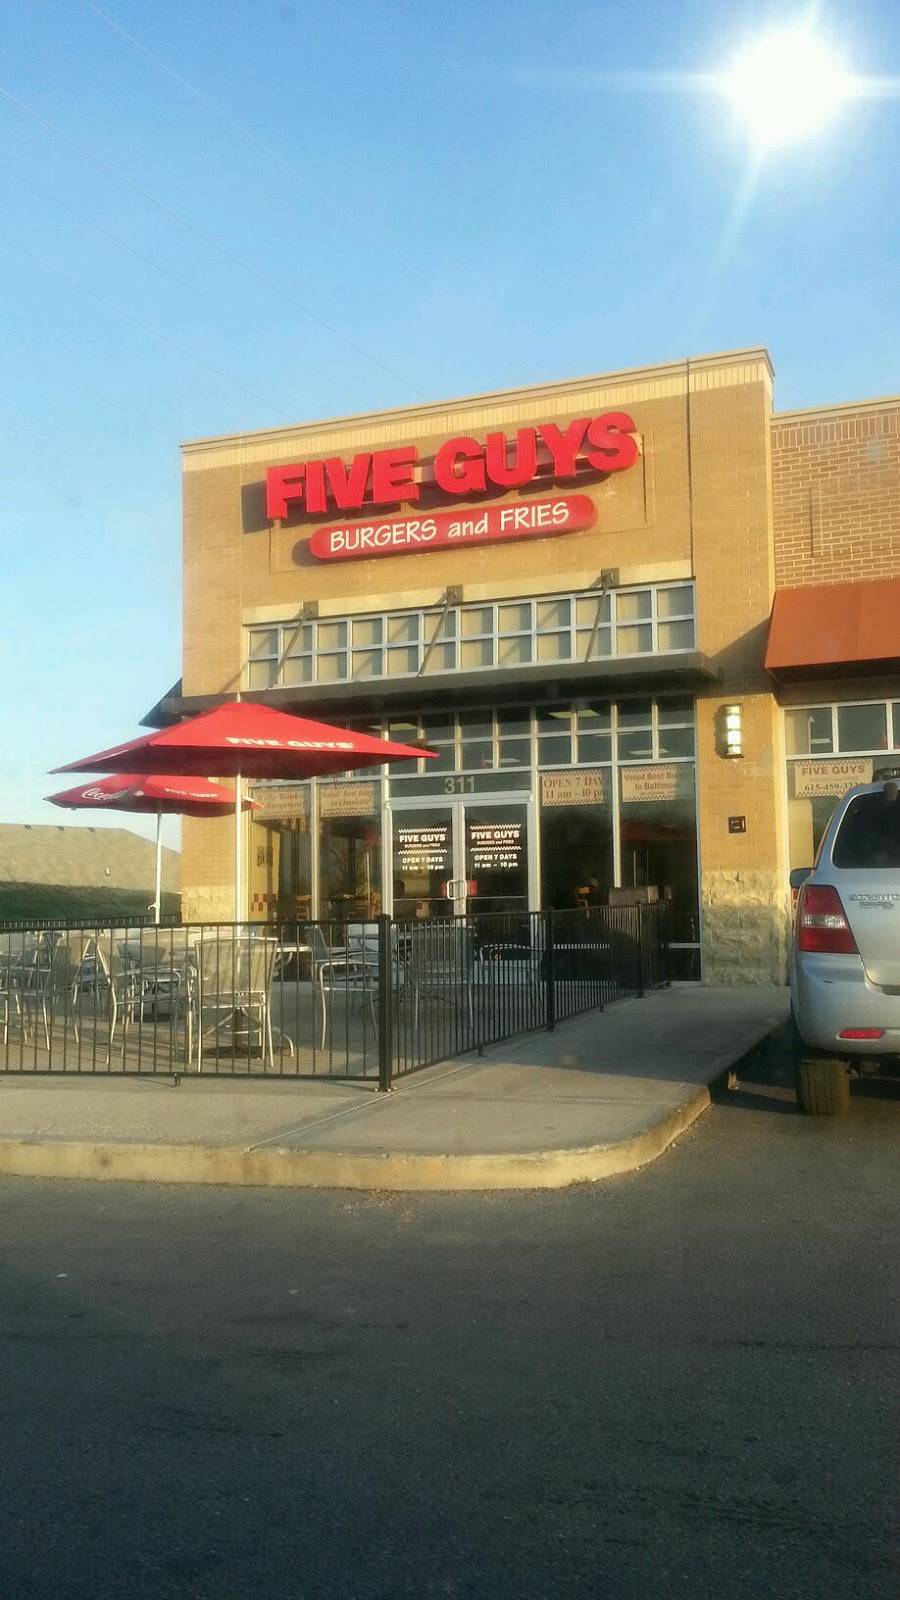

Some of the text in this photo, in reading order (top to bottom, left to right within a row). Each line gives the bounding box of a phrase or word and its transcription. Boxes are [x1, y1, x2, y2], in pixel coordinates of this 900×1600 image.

[265, 411, 642, 520] FIVE GUYS
[330, 501, 570, 553] BURGERS and FRIES
[802, 765, 865, 776] FIVE GUYS
[444, 776, 475, 794] 311
[544, 776, 605, 788] OPEN 7 DAY
[546, 790, 554, 799] 11
[582, 788, 590, 797] 10
[400, 833, 446, 842] FIVE GUYS
[471, 830, 520, 840] FIVE GUYS
